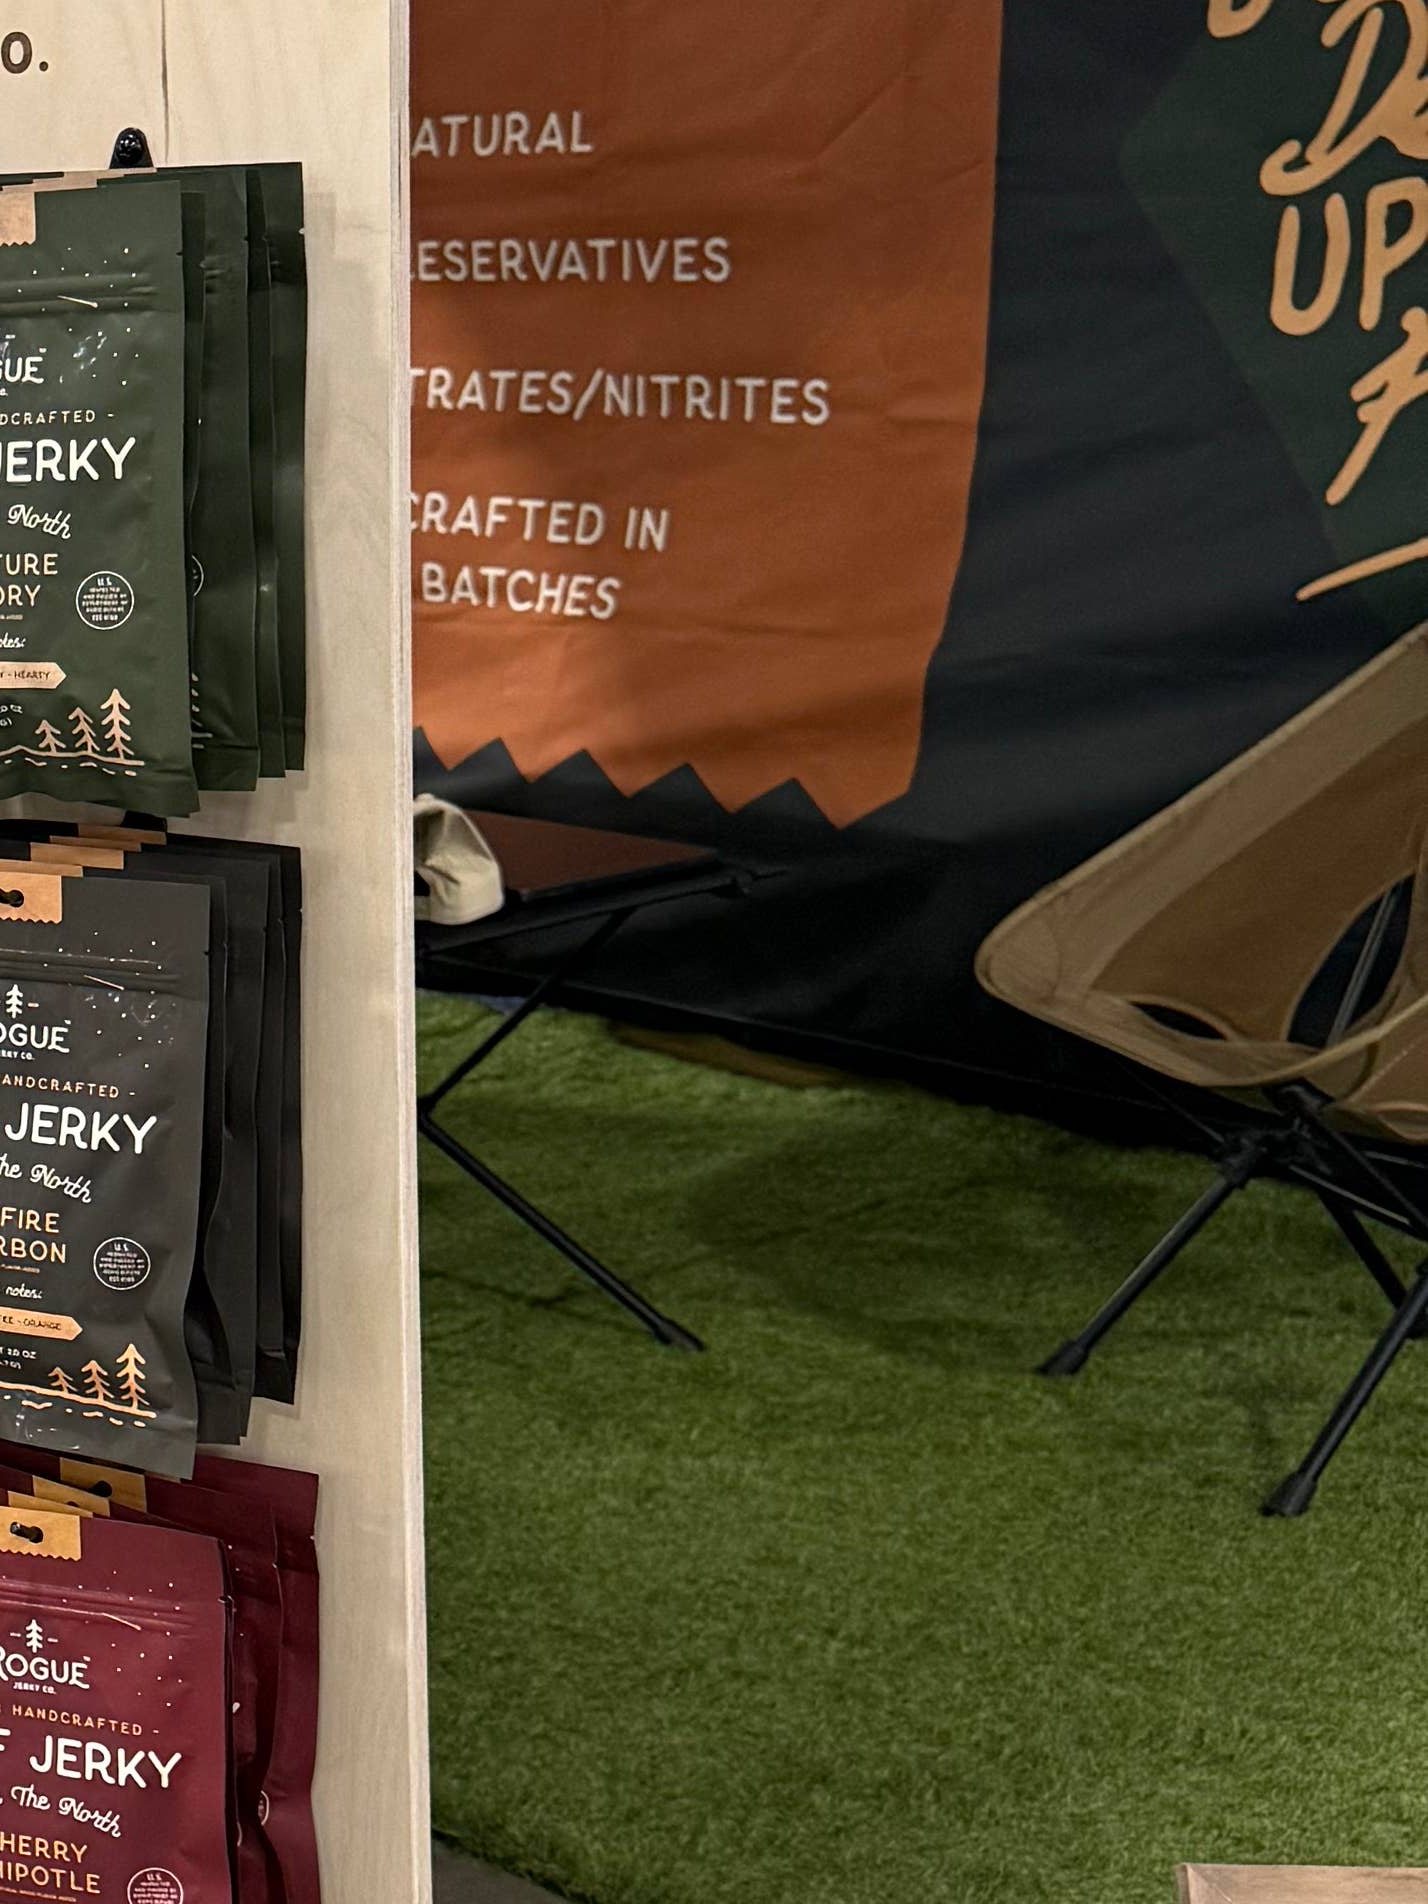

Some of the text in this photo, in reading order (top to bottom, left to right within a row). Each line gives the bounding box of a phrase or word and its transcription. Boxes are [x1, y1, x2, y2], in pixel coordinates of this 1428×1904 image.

[410, 110, 595, 159] ATURAL
[409, 236, 732, 283] ESERVATIVES
[409, 367, 831, 426] TRATES/NITRITES
[7, 503, 72, 540] North
[624, 506, 671, 552] IN
[421, 561, 623, 620] BATCHES
[4, 1102, 158, 1155] JERKY
[30, 1163, 93, 1204] North
[11, 1703, 143, 1736] HANDCRAFTED
[29, 1734, 183, 1789] JERKY
[10, 1783, 51, 1811] The
[58, 1796, 122, 1839] North
